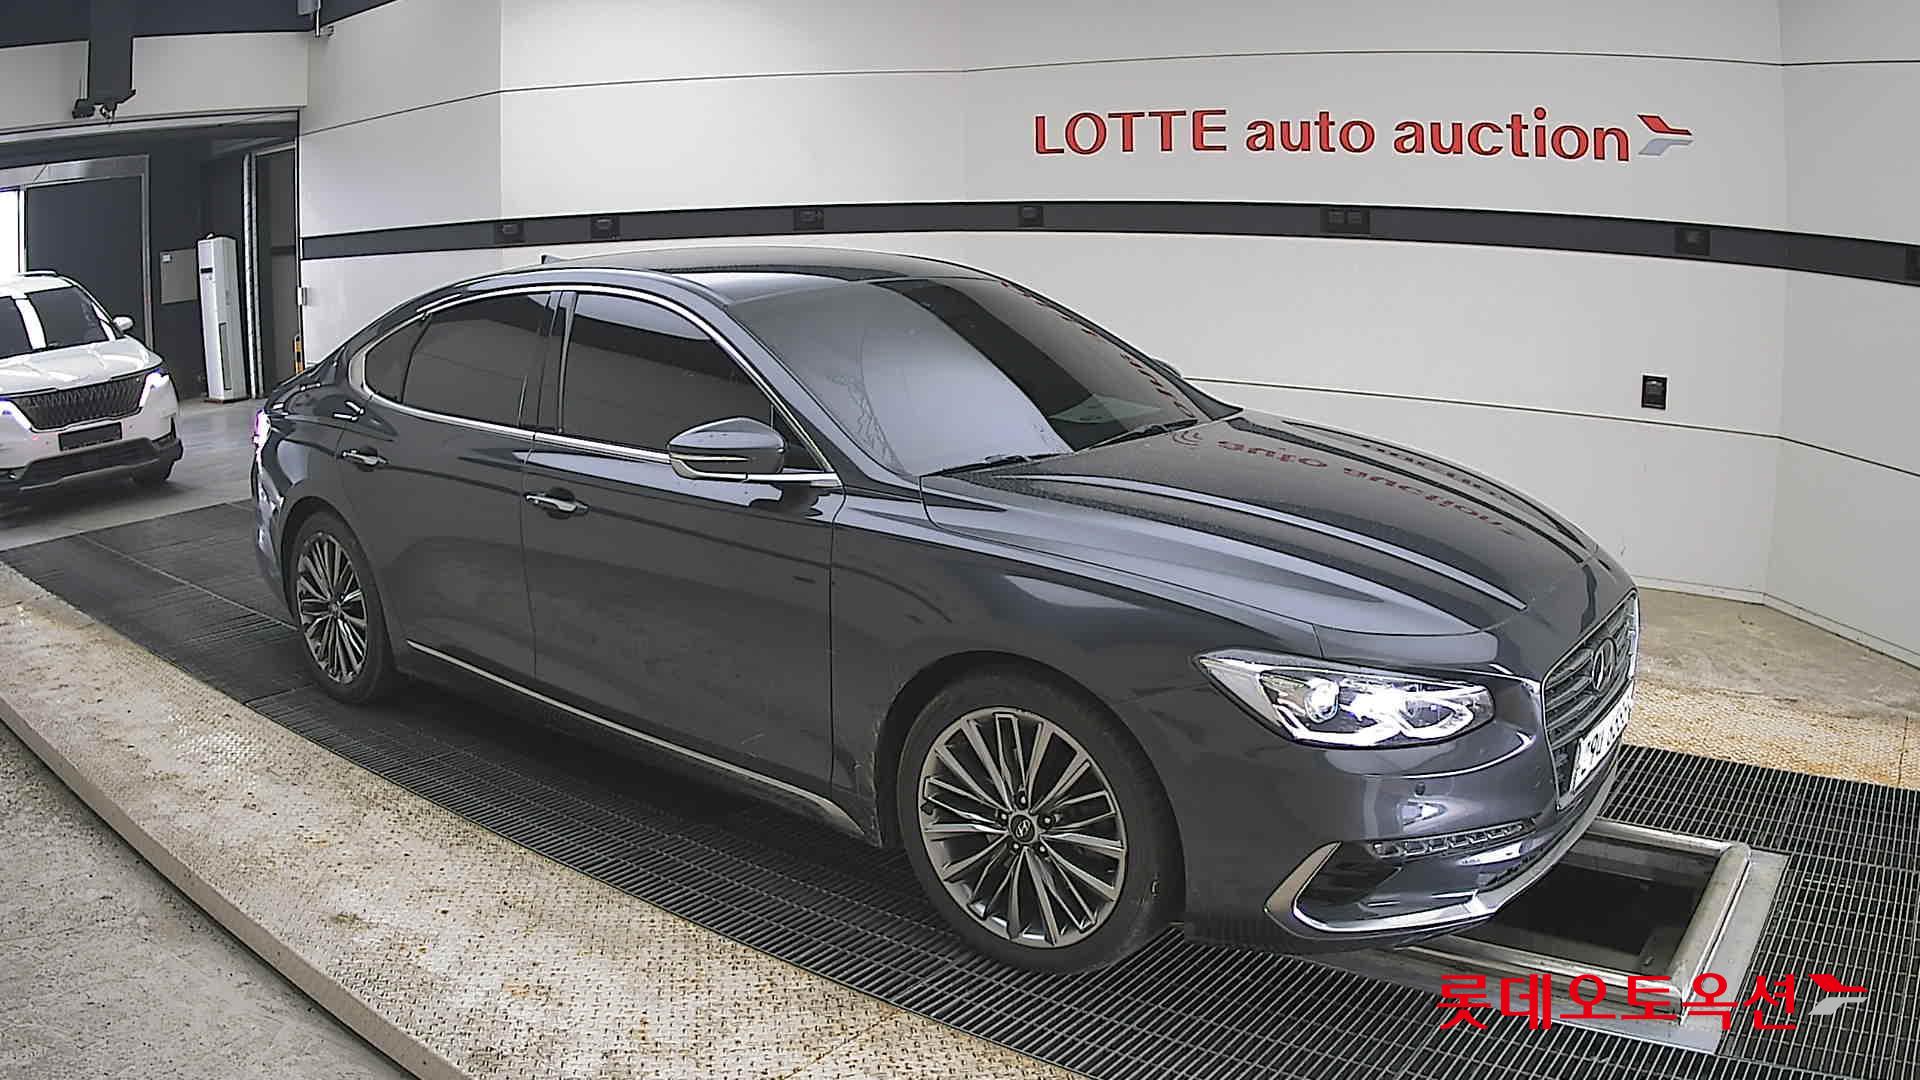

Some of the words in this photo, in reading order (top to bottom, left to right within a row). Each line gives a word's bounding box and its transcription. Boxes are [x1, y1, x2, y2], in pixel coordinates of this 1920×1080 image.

[1034, 109, 1227, 155] LOTTE
[1246, 111, 1376, 154] auto
[1393, 107, 1630, 162] auction
